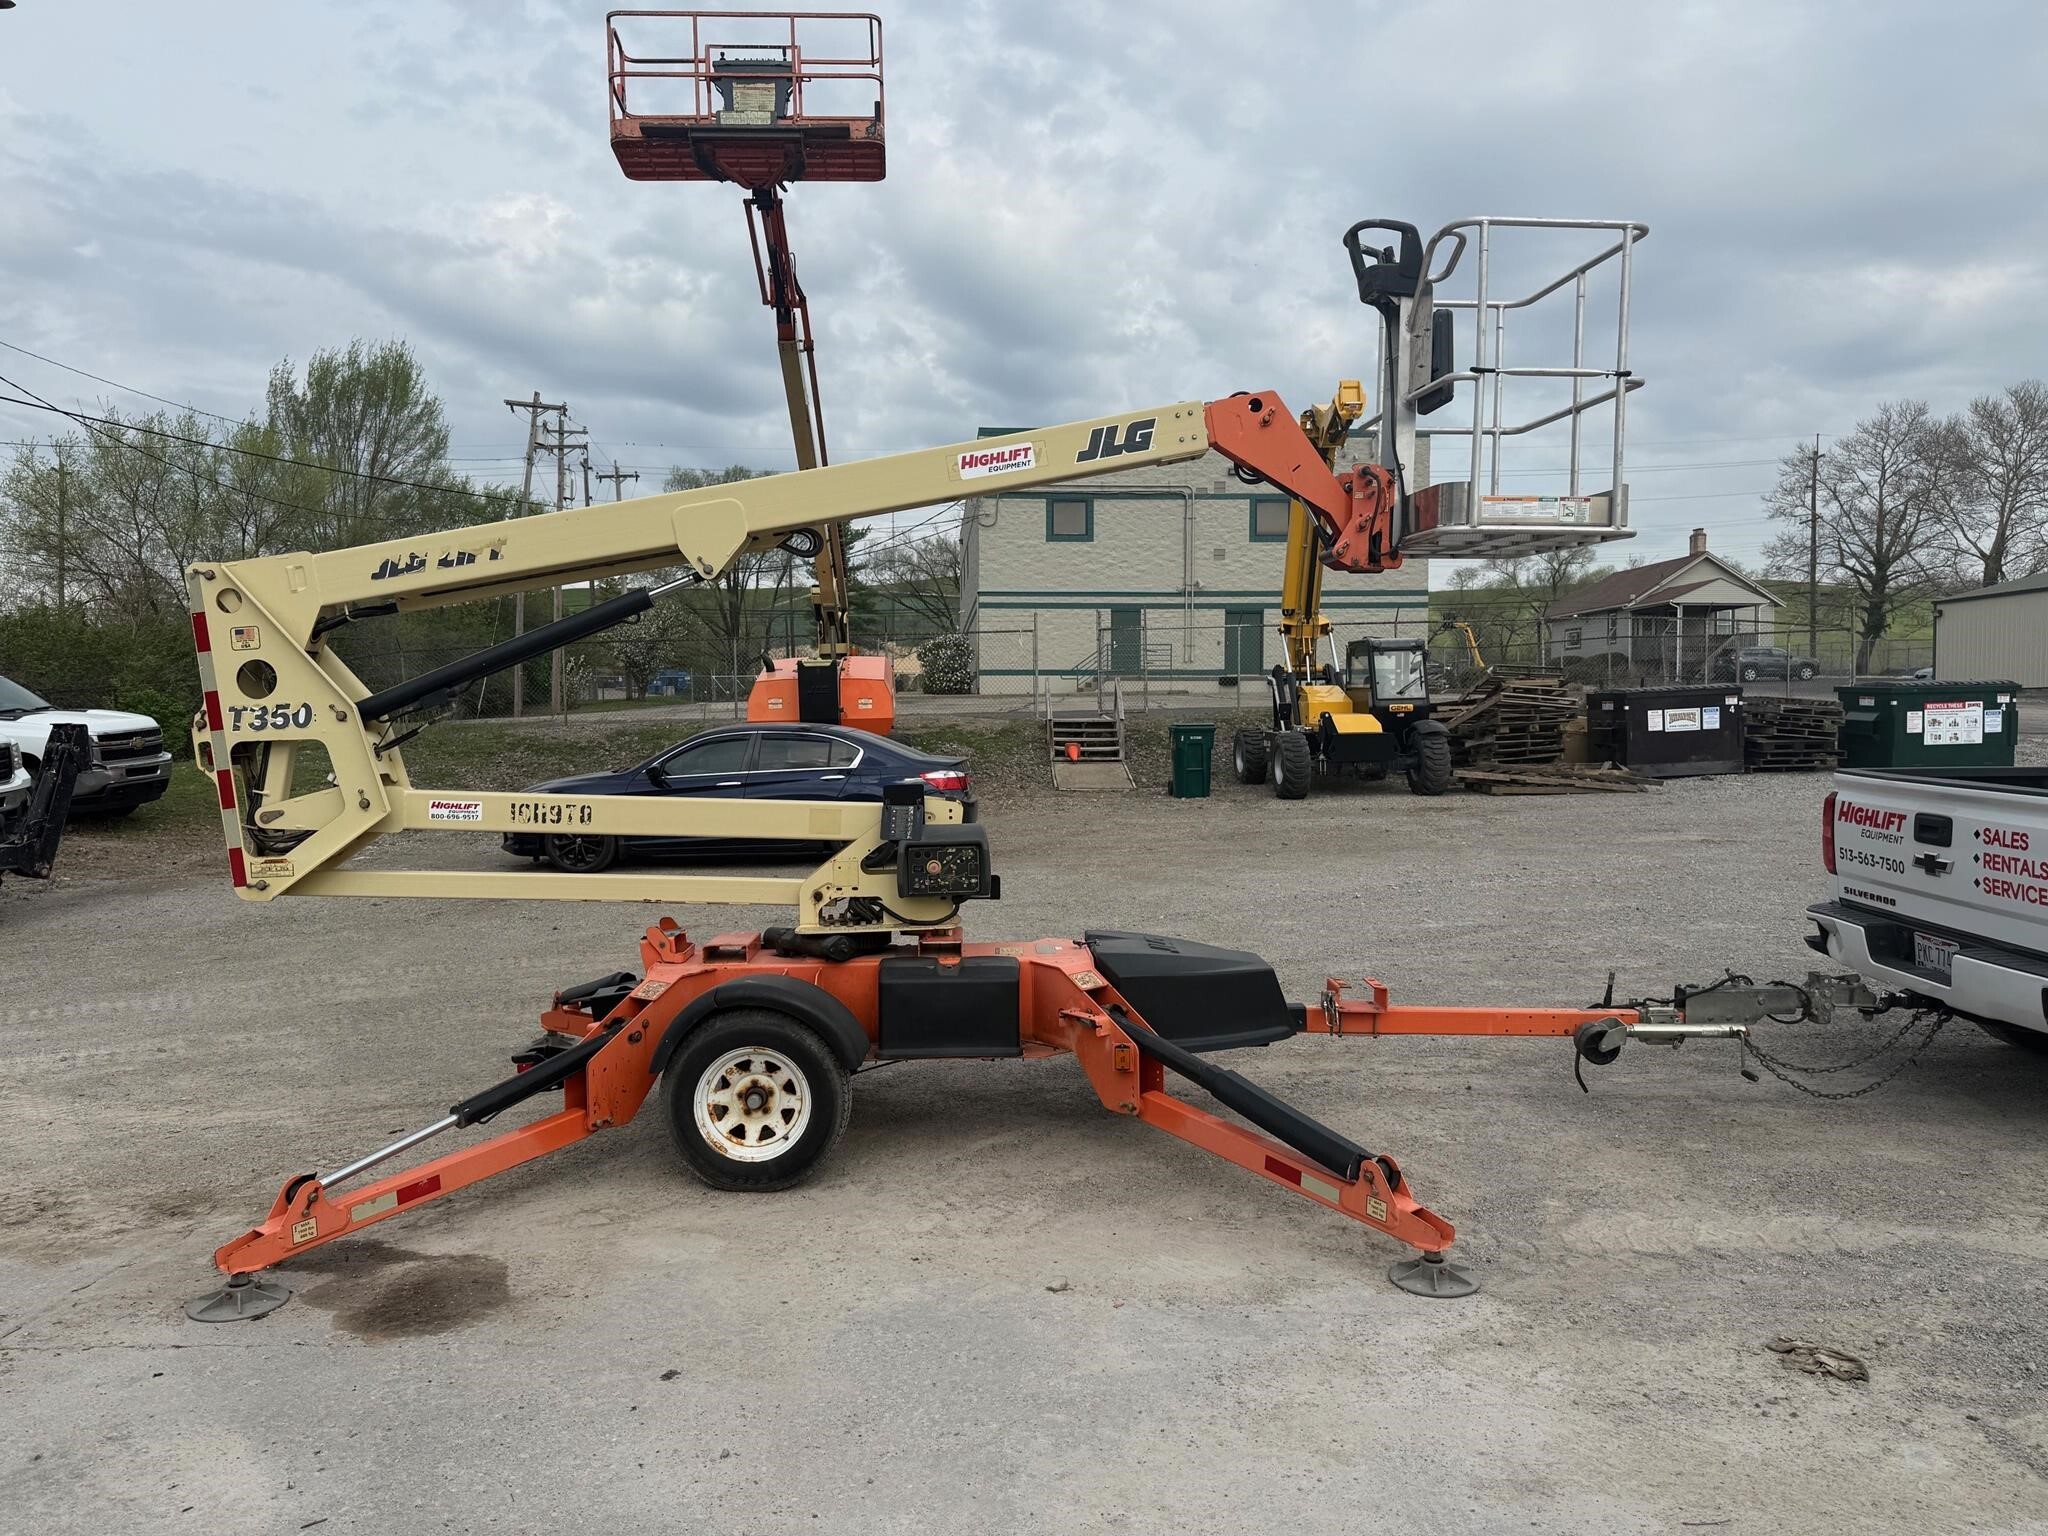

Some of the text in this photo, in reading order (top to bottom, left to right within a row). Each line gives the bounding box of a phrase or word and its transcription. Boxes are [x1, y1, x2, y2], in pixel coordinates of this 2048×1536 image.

[1075, 417, 1158, 463] JLG
[961, 446, 1031, 470] HIGHLIFT
[988, 460, 1032, 473] EQUIPMENT
[228, 702, 312, 732] T350
[1729, 705, 1735, 713] 4
[431, 801, 481, 810] HIGHLIFT
[1838, 800, 1907, 833] HIGHLIFT
[1860, 828, 1904, 846] EQUIPMENT
[1983, 827, 2029, 851] SALES
[1839, 846, 1905, 874] 513-563-7500
[1983, 852, 2048, 881] RENTALS
[1843, 886, 1897, 907] SILVERADO
[1982, 876, 2048, 906] SERVICE
